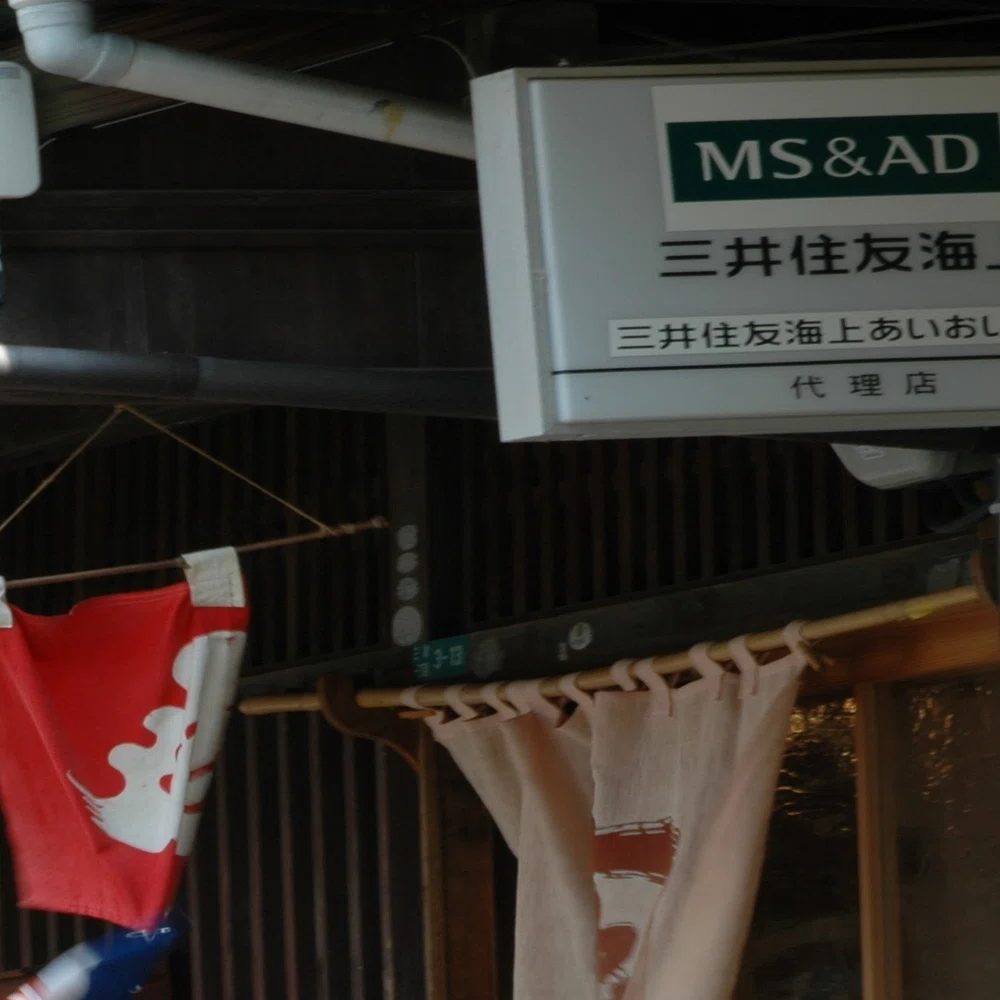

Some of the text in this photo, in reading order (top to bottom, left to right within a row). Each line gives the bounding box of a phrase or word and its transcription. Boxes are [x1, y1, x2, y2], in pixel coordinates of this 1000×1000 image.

[695, 133, 980, 182] MS&AD
[659, 229, 1000, 278] 三井住友海
[790, 371, 937, 399] 代理店
